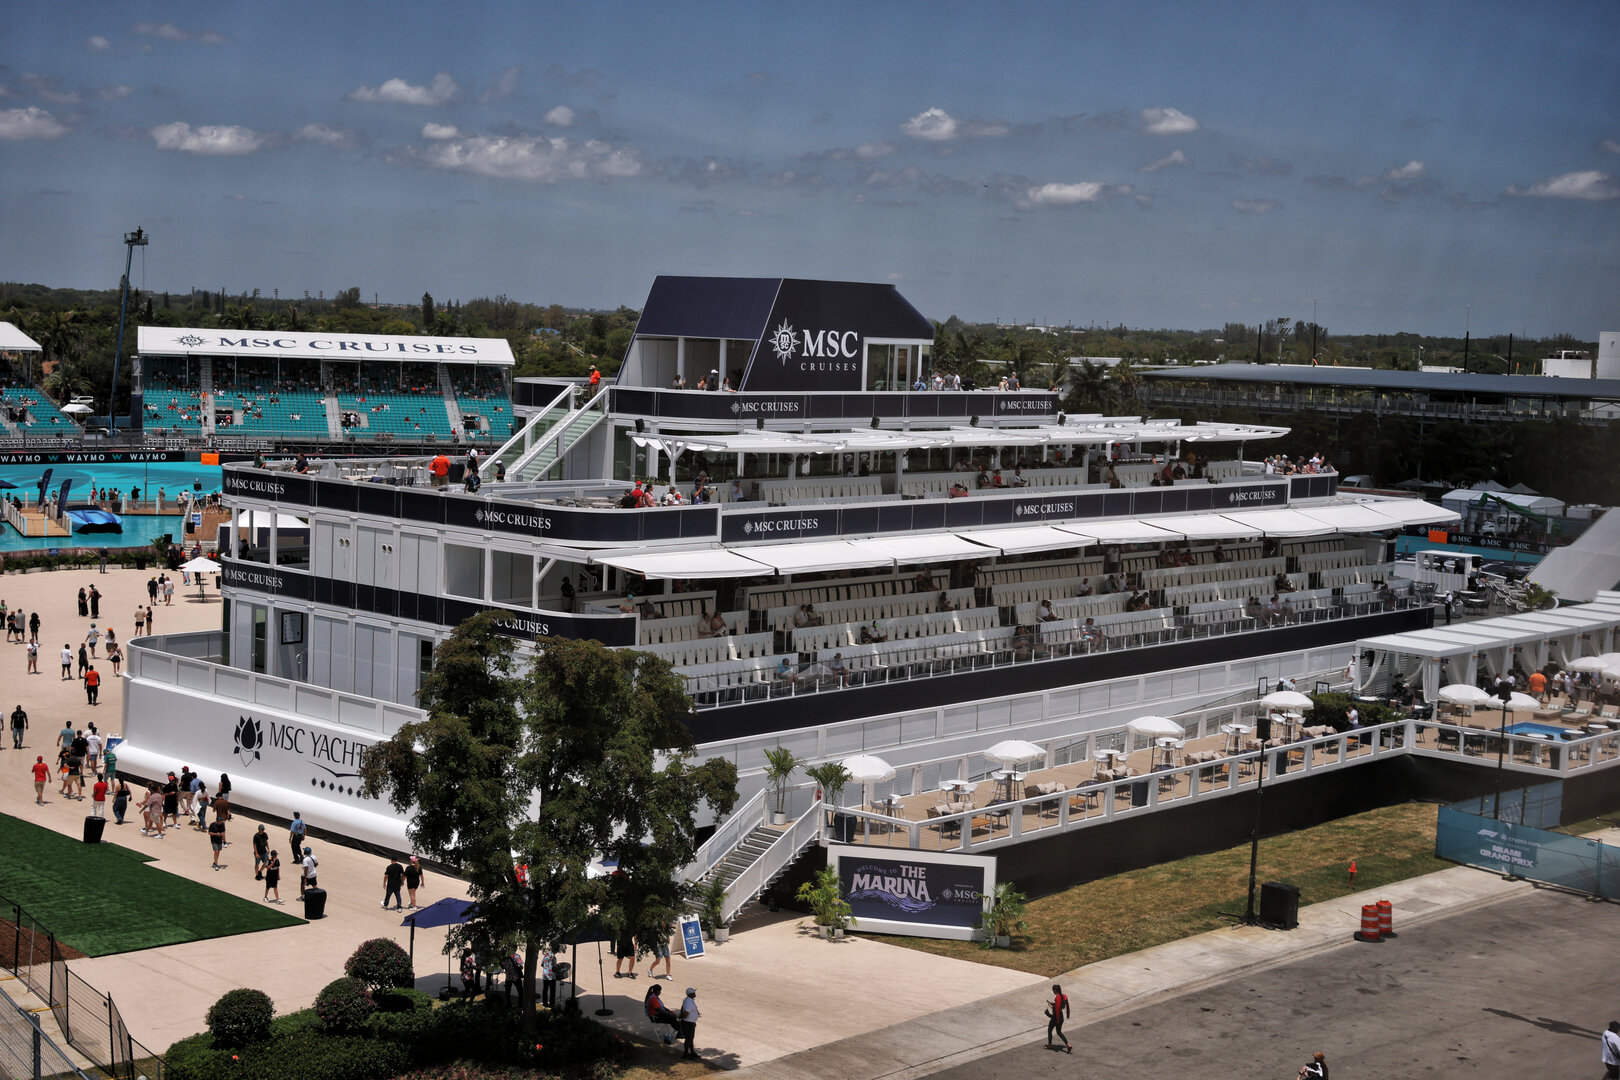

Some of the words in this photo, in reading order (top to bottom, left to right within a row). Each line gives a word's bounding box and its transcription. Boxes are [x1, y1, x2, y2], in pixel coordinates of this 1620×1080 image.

[218, 337, 297, 349] MSC
[308, 339, 479, 355] CRUISES
[801, 329, 858, 358] MSC
[800, 362, 857, 371] CRUISES
[741, 402, 760, 412] MSC
[760, 402, 799, 412] CRUISES
[1006, 401, 1021, 410] MSC
[1022, 401, 1053, 410] CRUISES
[0, 455, 41, 463] WAYMO
[129, 453, 167, 461] WAYMO
[231, 477, 249, 489] MSC
[249, 480, 285, 495] CRUISES
[1235, 492, 1249, 501] MSC
[1248, 490, 1276, 500] CRUISES
[1023, 504, 1040, 515] MSC
[1040, 502, 1074, 513] CRUISES
[484, 510, 506, 523] MSC
[507, 513, 552, 530] CRUISES
[753, 520, 775, 532] MSC
[776, 518, 819, 531] CRUISES
[1458, 535, 1472, 543] MSC
[1487, 539, 1502, 547] MSC
[1515, 542, 1531, 550] MSC
[230, 569, 248, 581] MSC
[248, 572, 283, 588] CRUISES
[269, 722, 306, 754] MSC
[310, 731, 368, 769] YACHT
[1479, 848, 1511, 862] GRAND
[1511, 856, 1534, 868] PRIX
[1491, 844, 1522, 858] MIAMI
[856, 864, 887, 874] WELCOME
[899, 864, 927, 879] THE
[850, 873, 932, 902] MARINA
[954, 889, 979, 900] MSC
